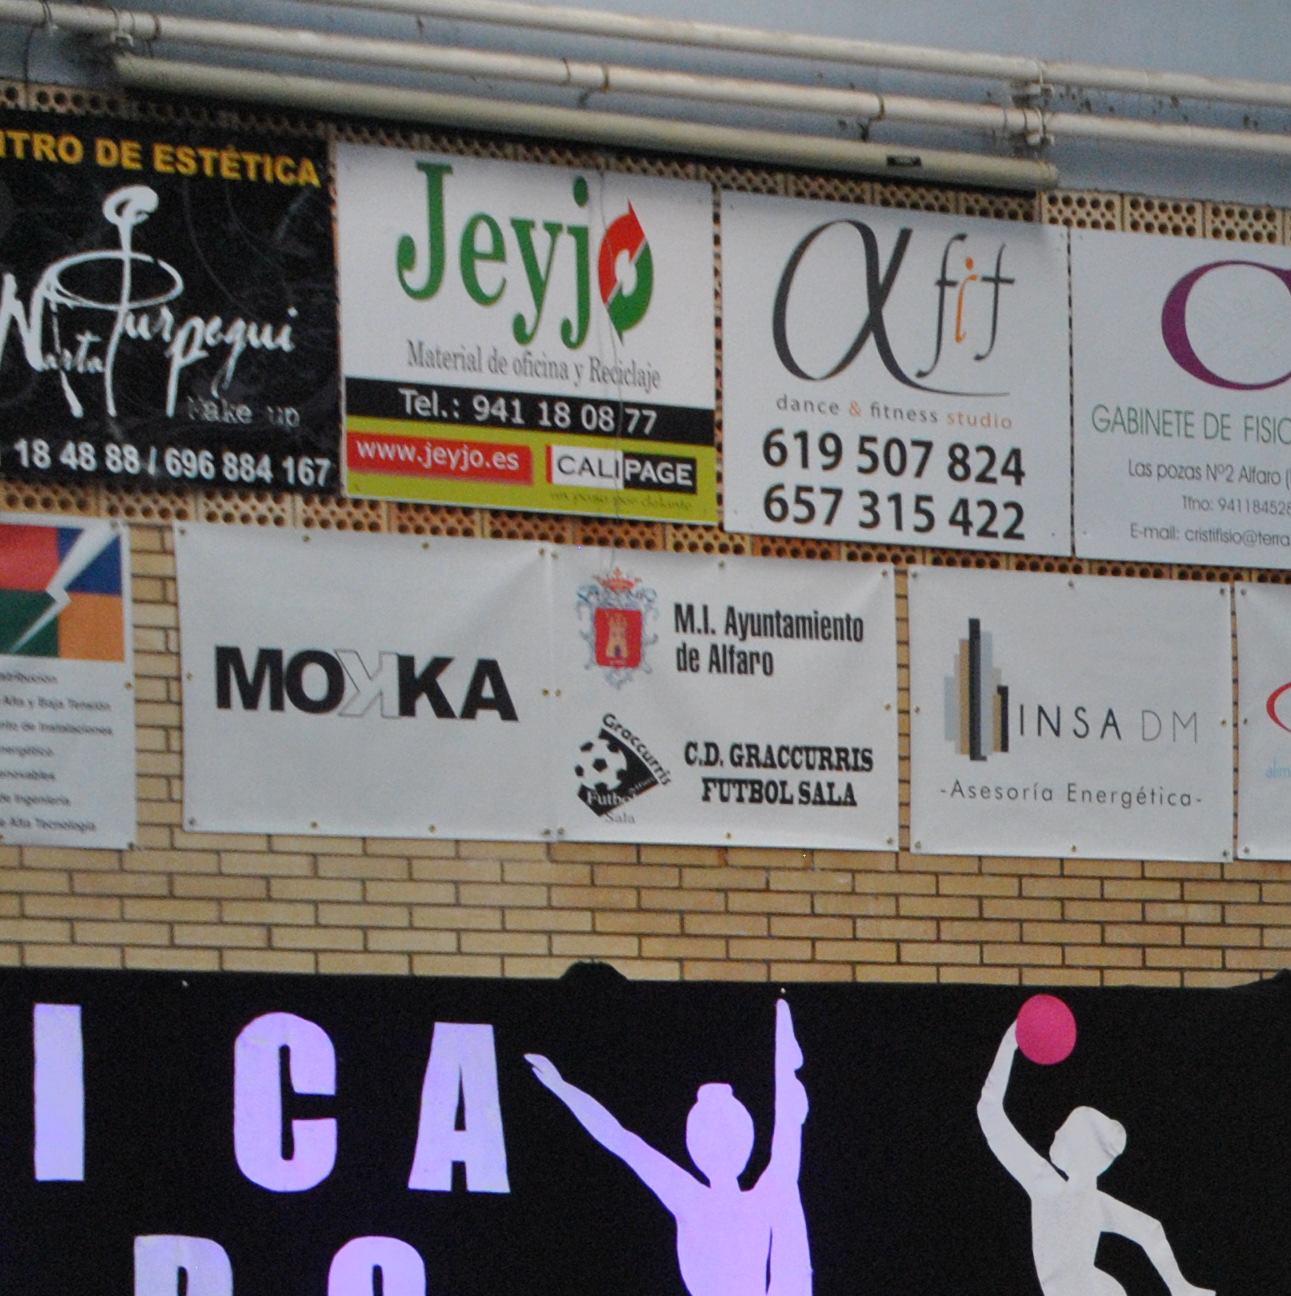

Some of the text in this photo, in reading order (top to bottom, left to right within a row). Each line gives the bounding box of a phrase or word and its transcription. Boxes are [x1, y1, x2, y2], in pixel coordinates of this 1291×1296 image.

[95, 137, 143, 170] DE
[153, 143, 321, 188] ESTÉTICA
[395, 160, 655, 349] Jeyjo
[407, 338, 662, 393] Material de oficina y Reciclaje
[398, 388, 658, 436] Tel.: 941 18 08 77
[776, 394, 1012, 430] dance & fitness studio
[1091, 404, 1195, 439] GABINETE
[1204, 413, 1231, 441] DE
[13, 438, 51, 470] 18
[59, 440, 97, 472] 48
[105, 443, 141, 475] 88
[164, 449, 216, 480] 696
[222, 450, 274, 483] 884
[282, 455, 331, 487] 167
[356, 438, 520, 472] www.jeyjo.es
[762, 428, 1025, 486] 619 507 824
[1128, 459, 1151, 478] Las
[1157, 463, 1201, 481] pozas
[1238, 466, 1281, 485] Alfaro
[763, 483, 1025, 541] 657 315 422
[1130, 522, 1179, 541] E-mail:
[674, 603, 864, 643] M.I. Ayuntamiento
[676, 643, 774, 676] de Alfaro
[1019, 704, 1198, 743] INSA DM
[602, 713, 671, 786] Graccurris
[684, 742, 874, 773] C.D. GRACCURRIS
[701, 777, 857, 807] FUTBOL SALA
